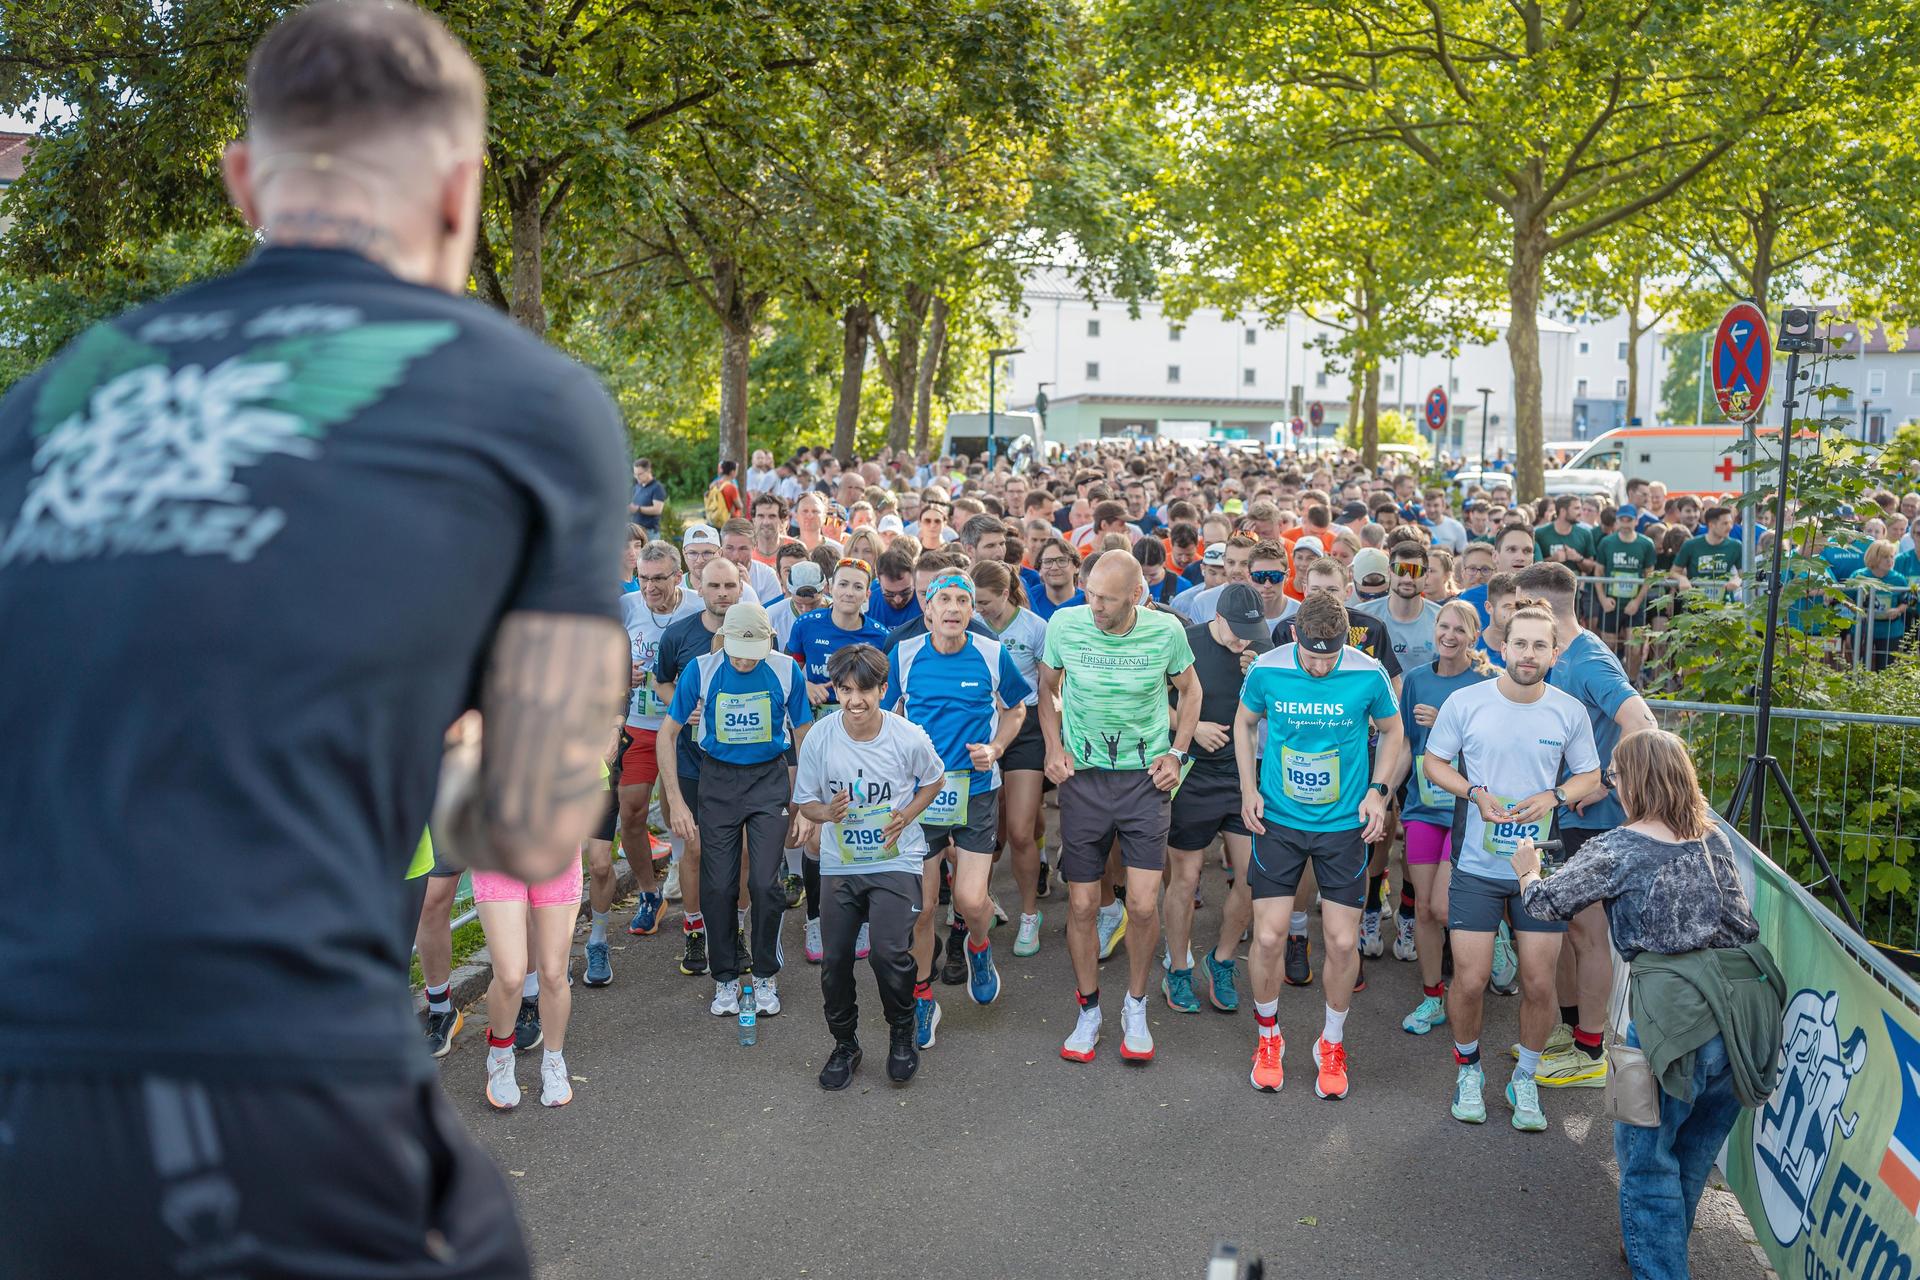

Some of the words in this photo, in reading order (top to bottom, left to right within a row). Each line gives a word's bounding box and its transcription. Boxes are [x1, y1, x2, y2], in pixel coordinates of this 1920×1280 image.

[1083, 655, 1116, 665] FRISEUR
[1275, 701, 1345, 716] SIEMENS
[725, 712, 760, 727] 345
[1287, 717, 1327, 730] Ingenuity
[1327, 719, 1341, 728] for
[1341, 718, 1353, 727] life
[1287, 767, 1330, 786] 1893
[933, 790, 958, 806] 36
[843, 828, 886, 845] 2196
[1493, 822, 1540, 841] 1842
[1491, 837, 1518, 846] Maximili
[1820, 1162, 1920, 1280] Firm
